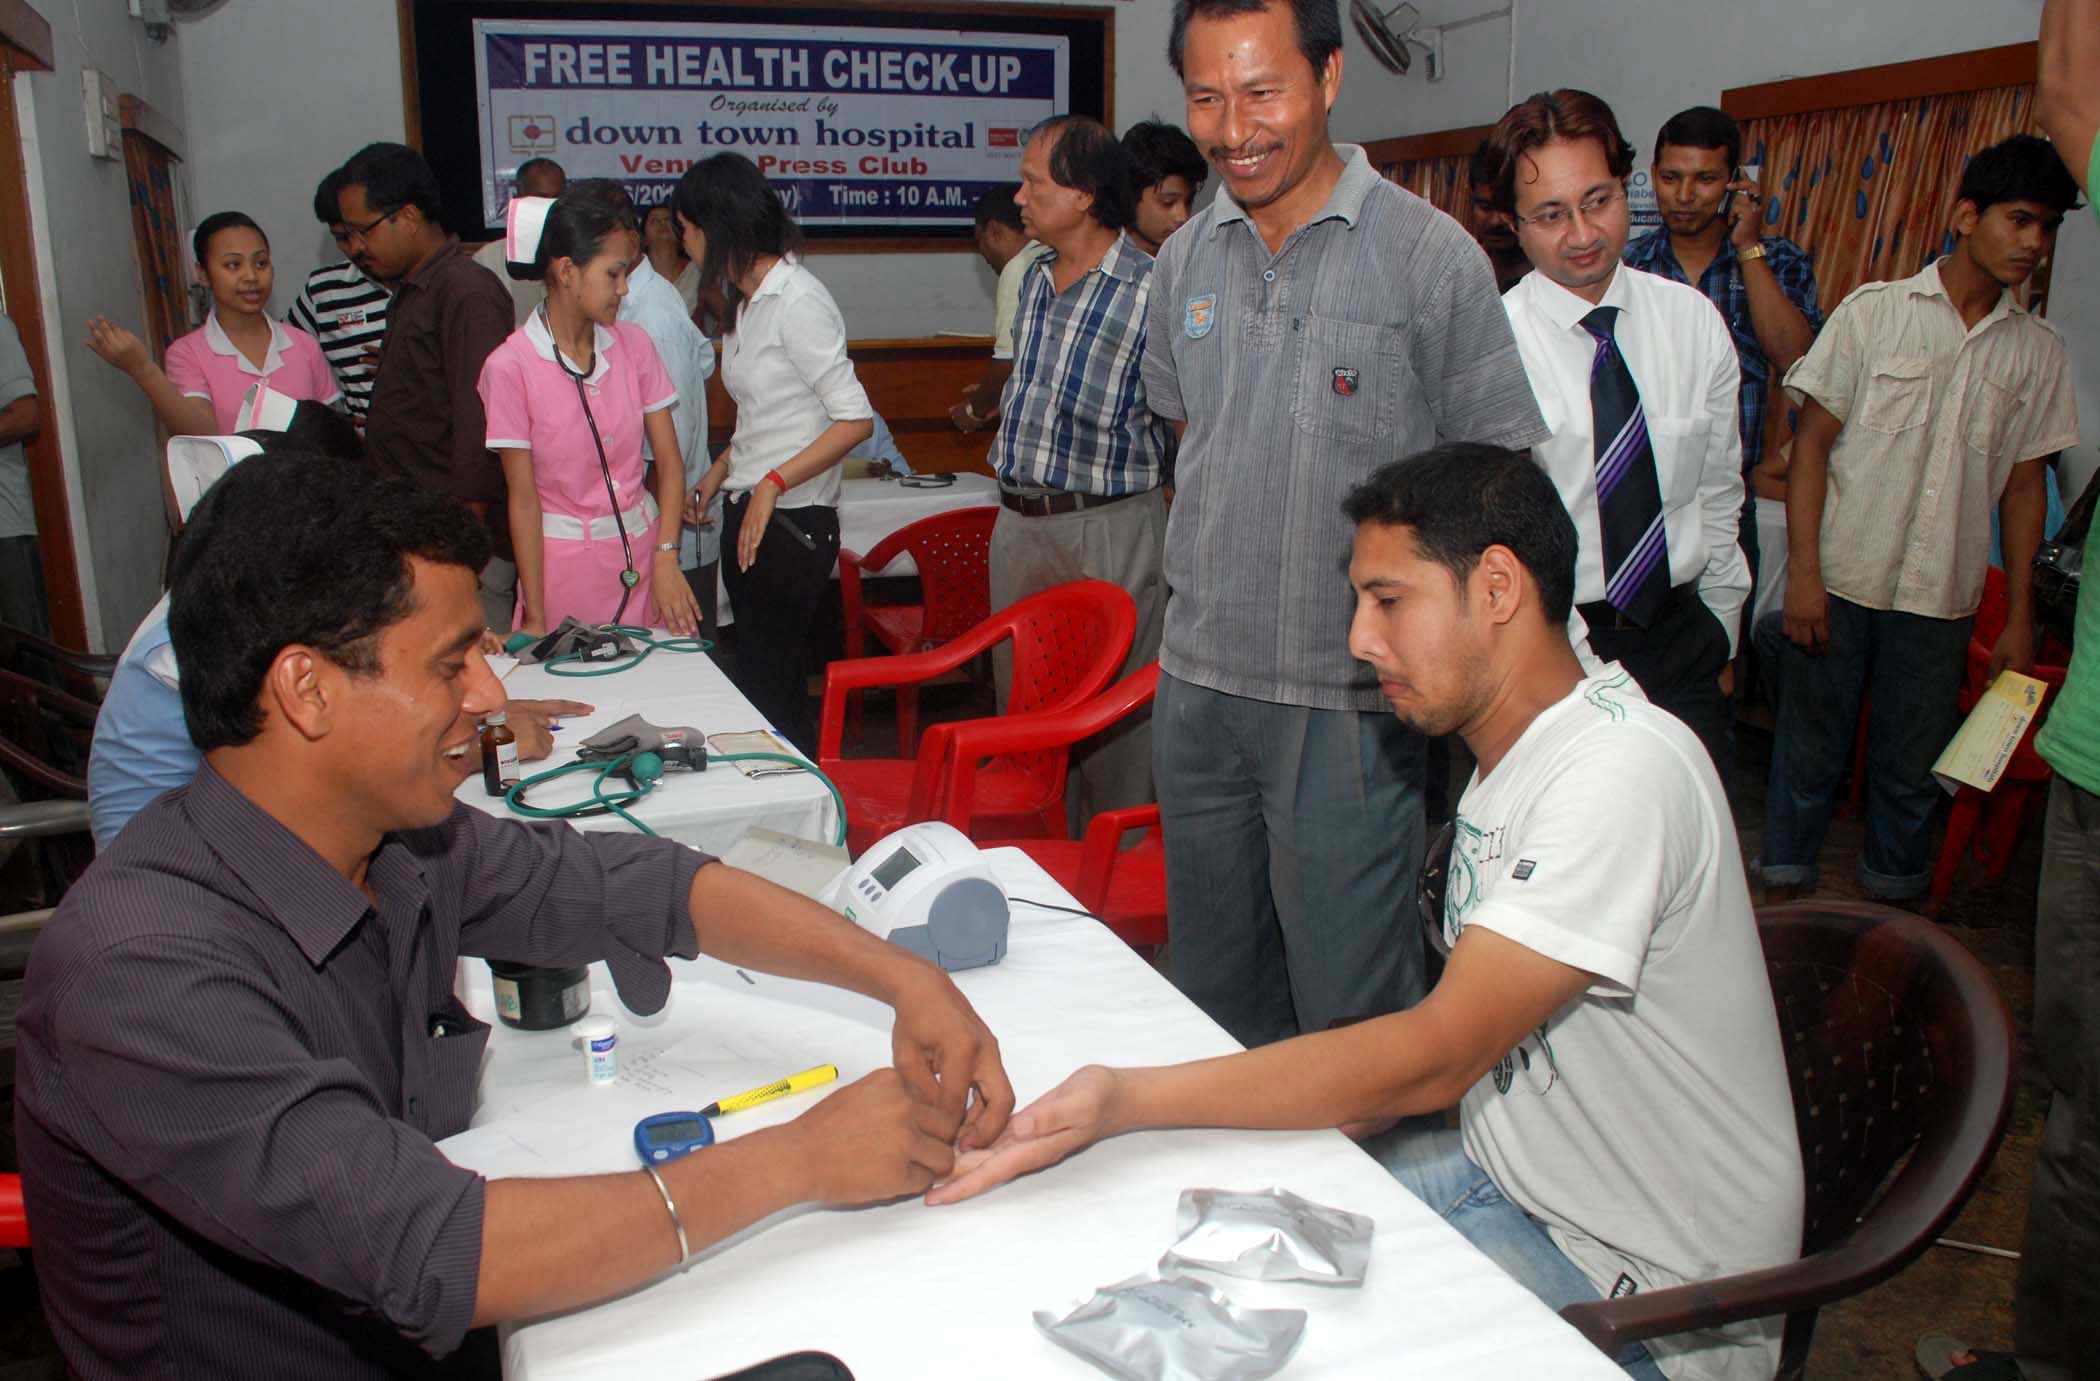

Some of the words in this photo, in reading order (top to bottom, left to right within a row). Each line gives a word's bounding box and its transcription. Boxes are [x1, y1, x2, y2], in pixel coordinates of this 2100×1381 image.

[524, 43, 633, 84] FREE
[646, 45, 809, 87] HEALTH
[823, 49, 1021, 93] CHECK-UP
[710, 94, 809, 117] Organised
[816, 96, 839, 117] by
[565, 116, 682, 145] down
[697, 120, 801, 146] town
[815, 118, 975, 152] hospital
[619, 155, 694, 174] Ven
[757, 155, 847, 174] Press
[858, 156, 928, 175] Club
[828, 184, 880, 206] Time
[896, 185, 919, 206] 10
[925, 187, 967, 207] A.M.
